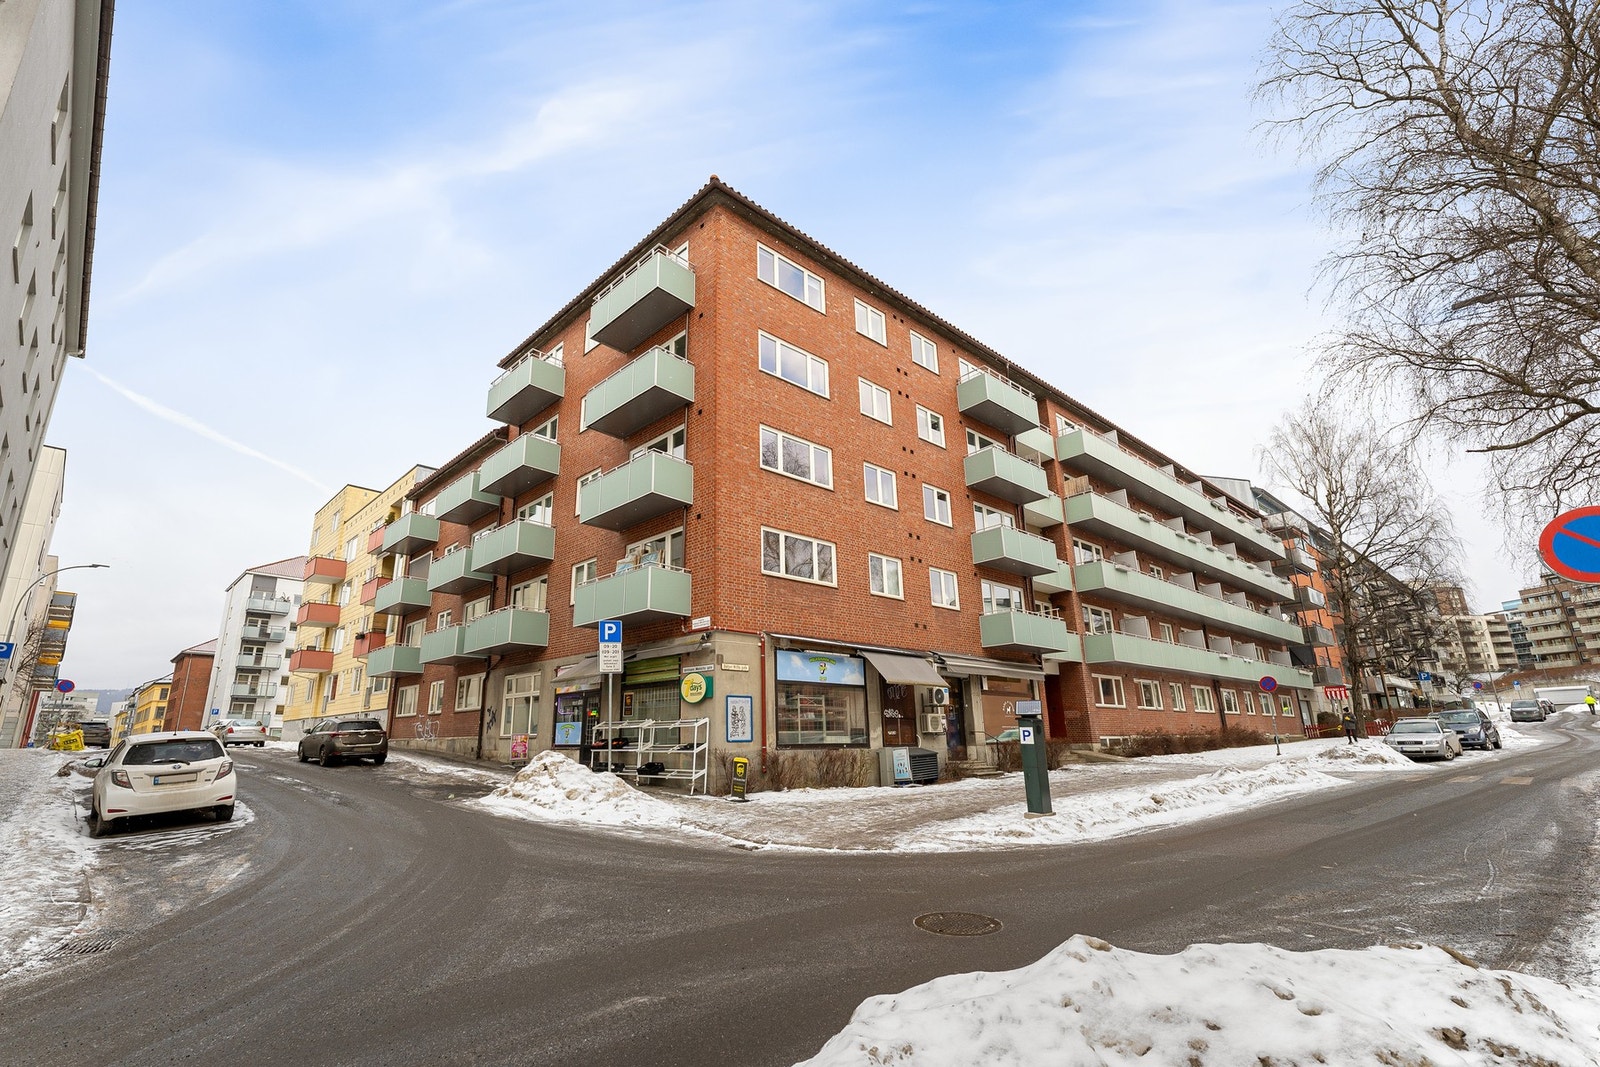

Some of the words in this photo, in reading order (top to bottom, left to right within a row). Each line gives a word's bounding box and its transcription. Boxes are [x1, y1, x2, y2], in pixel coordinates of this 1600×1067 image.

[604, 623, 617, 640] P
[684, 679, 691, 698] 7
[690, 683, 702, 692] days
[1022, 729, 1031, 742] P
